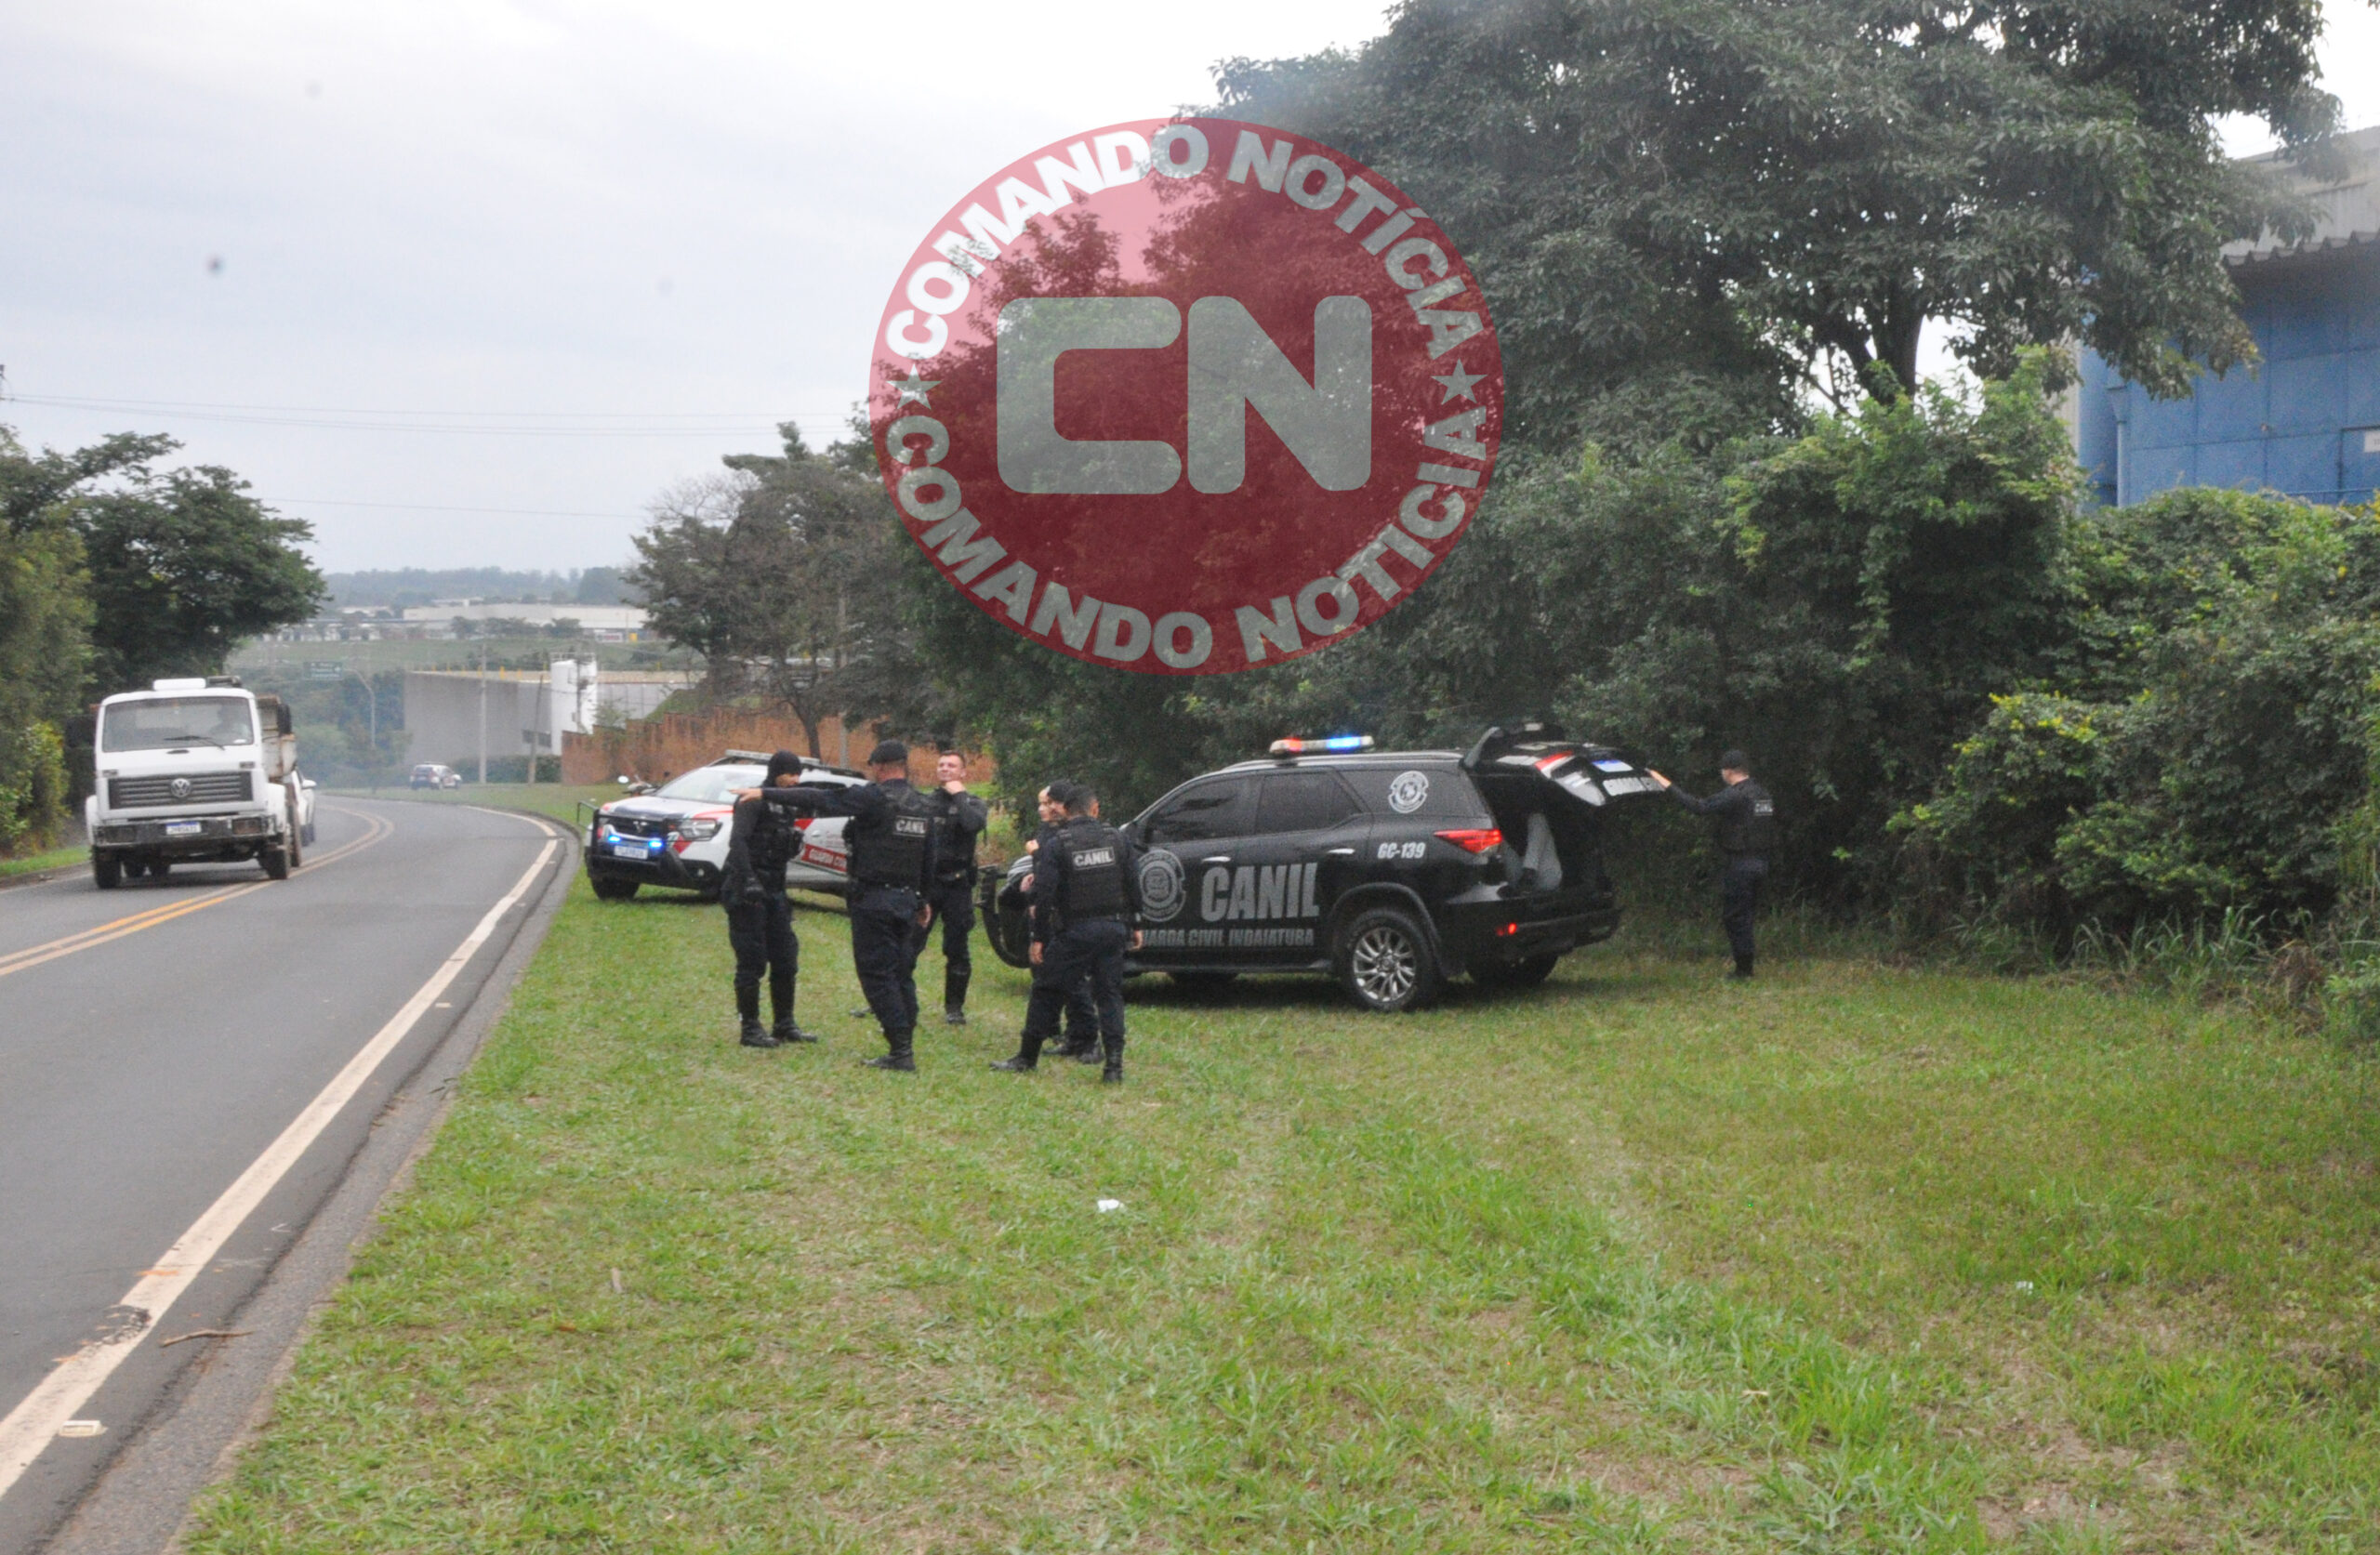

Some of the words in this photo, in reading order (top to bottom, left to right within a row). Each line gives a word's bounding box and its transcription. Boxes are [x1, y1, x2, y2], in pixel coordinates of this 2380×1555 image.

[1074, 850, 1113, 867] CANIL
[1377, 841, 1426, 860] GC-139
[1201, 863, 1320, 922] CANIL
[1143, 929, 1185, 947] UARDA
[1187, 929, 1225, 947] CIVIL
[1228, 928, 1315, 947] INDAIATUBA
